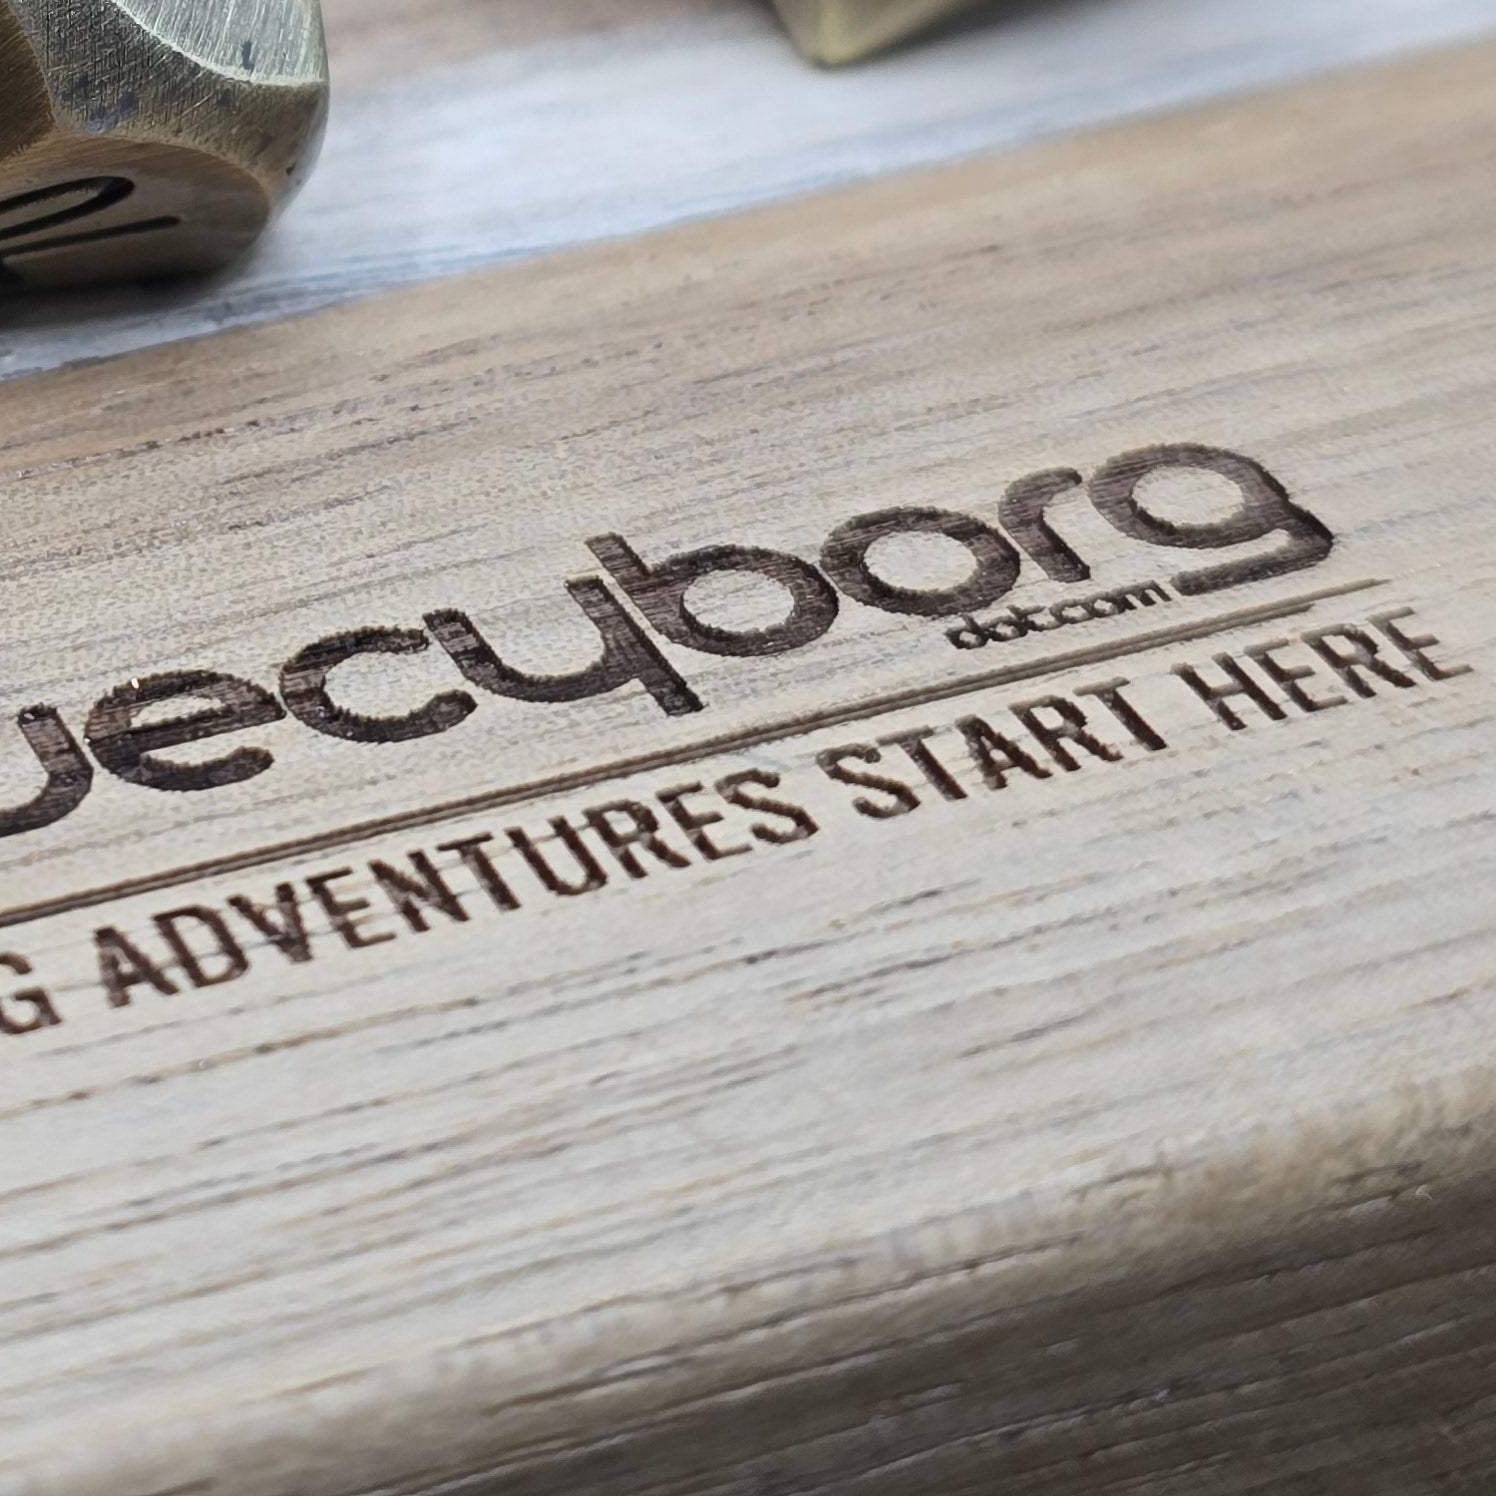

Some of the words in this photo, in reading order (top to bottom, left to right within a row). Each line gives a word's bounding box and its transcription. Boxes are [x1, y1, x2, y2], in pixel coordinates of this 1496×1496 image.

[92, 767, 821, 1010] ADVENTURES
[816, 676, 1169, 821] START
[1171, 606, 1475, 731] HERE
